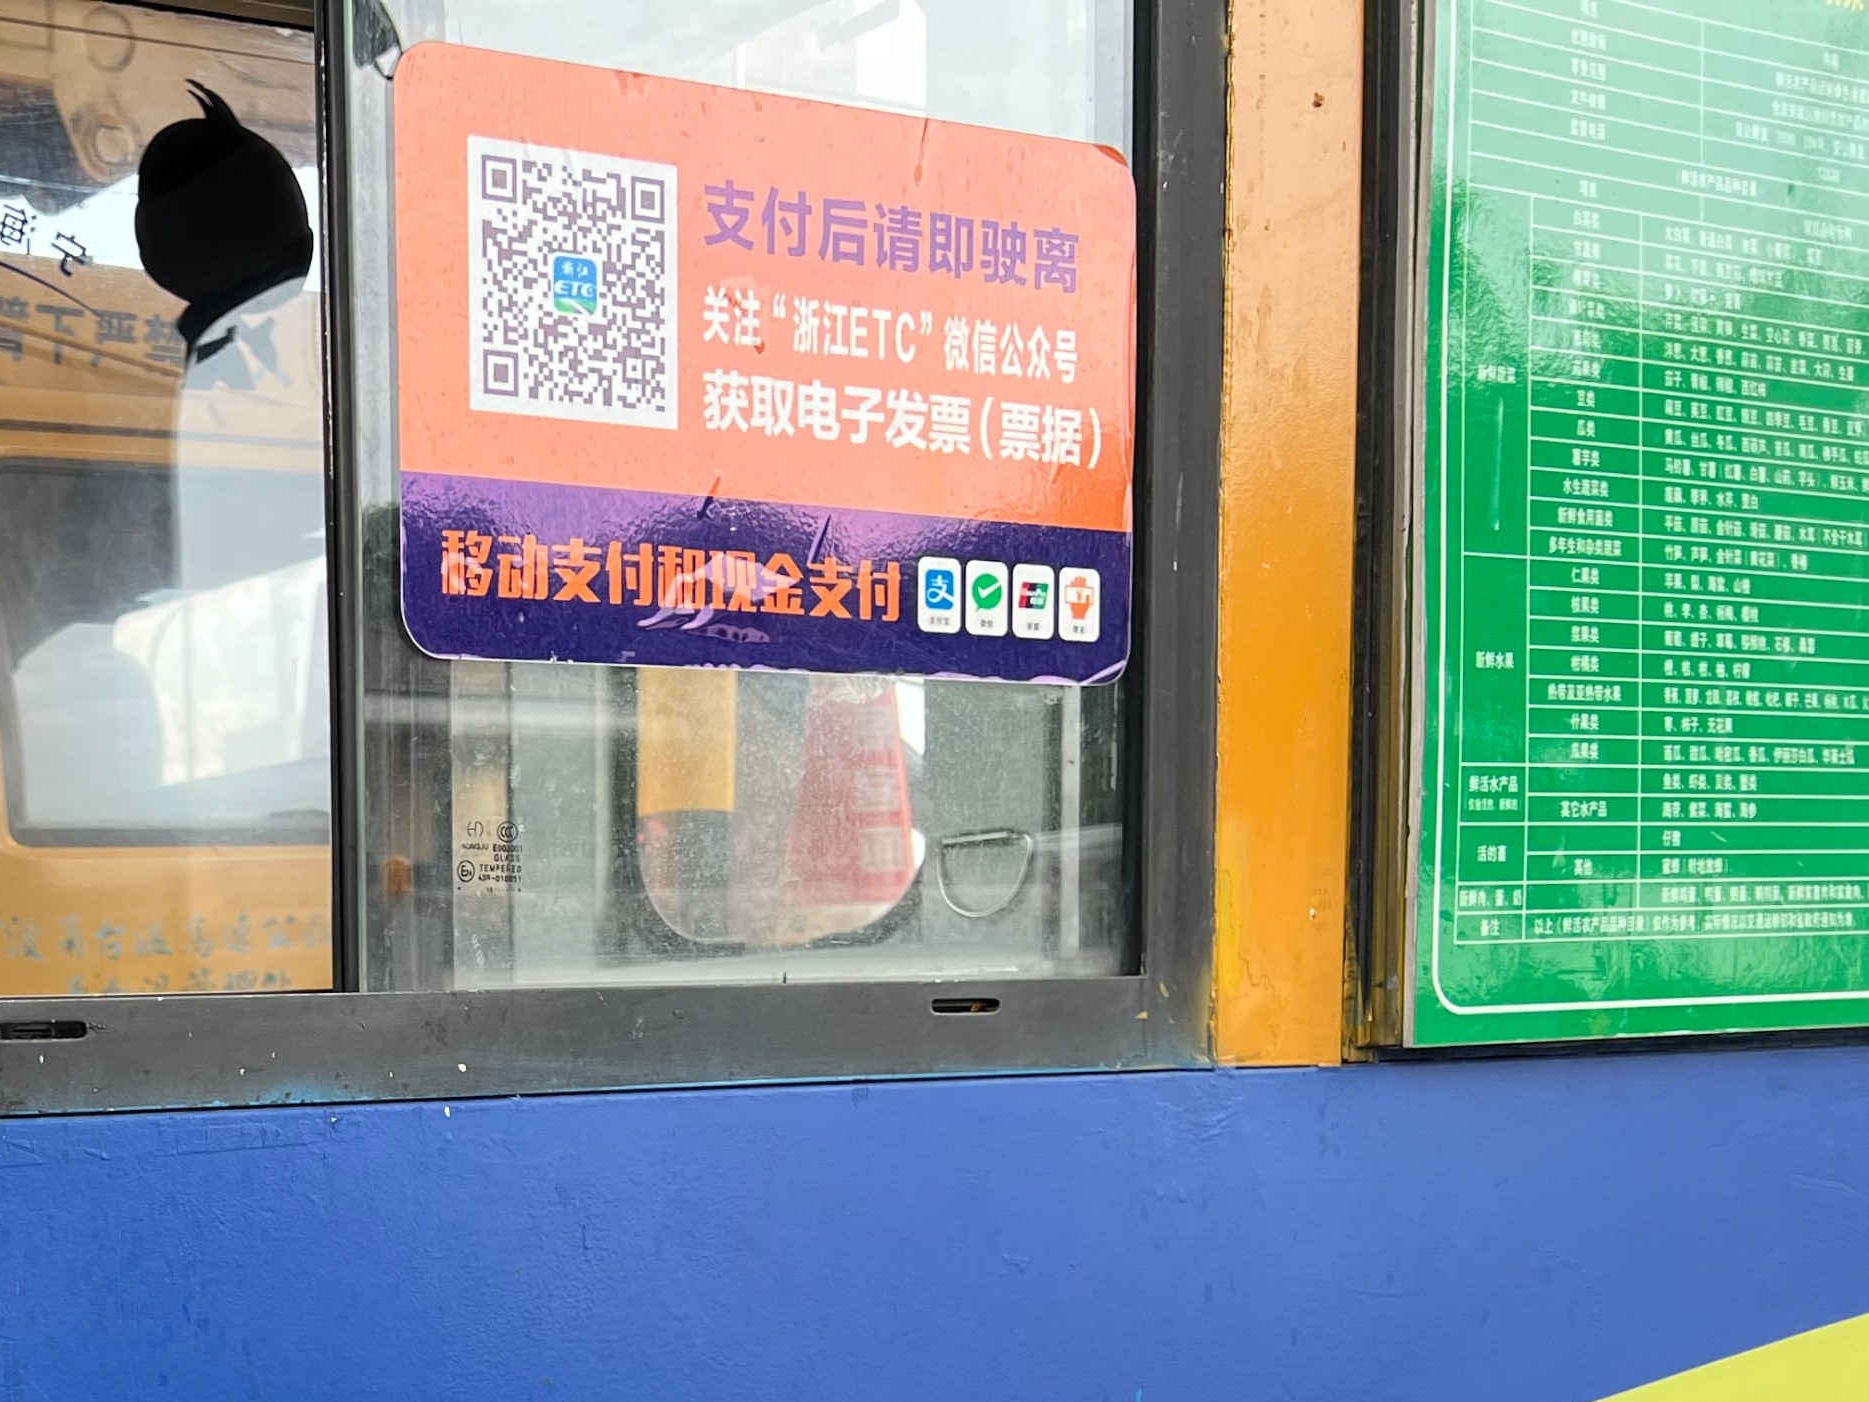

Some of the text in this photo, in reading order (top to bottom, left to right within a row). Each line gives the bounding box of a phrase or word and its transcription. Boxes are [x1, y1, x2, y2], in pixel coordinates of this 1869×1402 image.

[703, 179, 1080, 294] 支付后请即驶离
[702, 285, 1079, 384] 关注“浙江ETC”微信公众号
[702, 367, 1102, 471] 获取电子发票（票据）
[440, 528, 902, 624] 移动支付和现金支付
[1571, 566, 1600, 586] 仁果类
[1475, 650, 1515, 670] 新鲜水果
[1468, 775, 1519, 794] 鲜活水产品
[1559, 799, 1608, 818] 其它水产品
[493, 853, 521, 862] GLASS
[479, 863, 522, 873] TEMPERED
[1480, 918, 1500, 937] 备注
